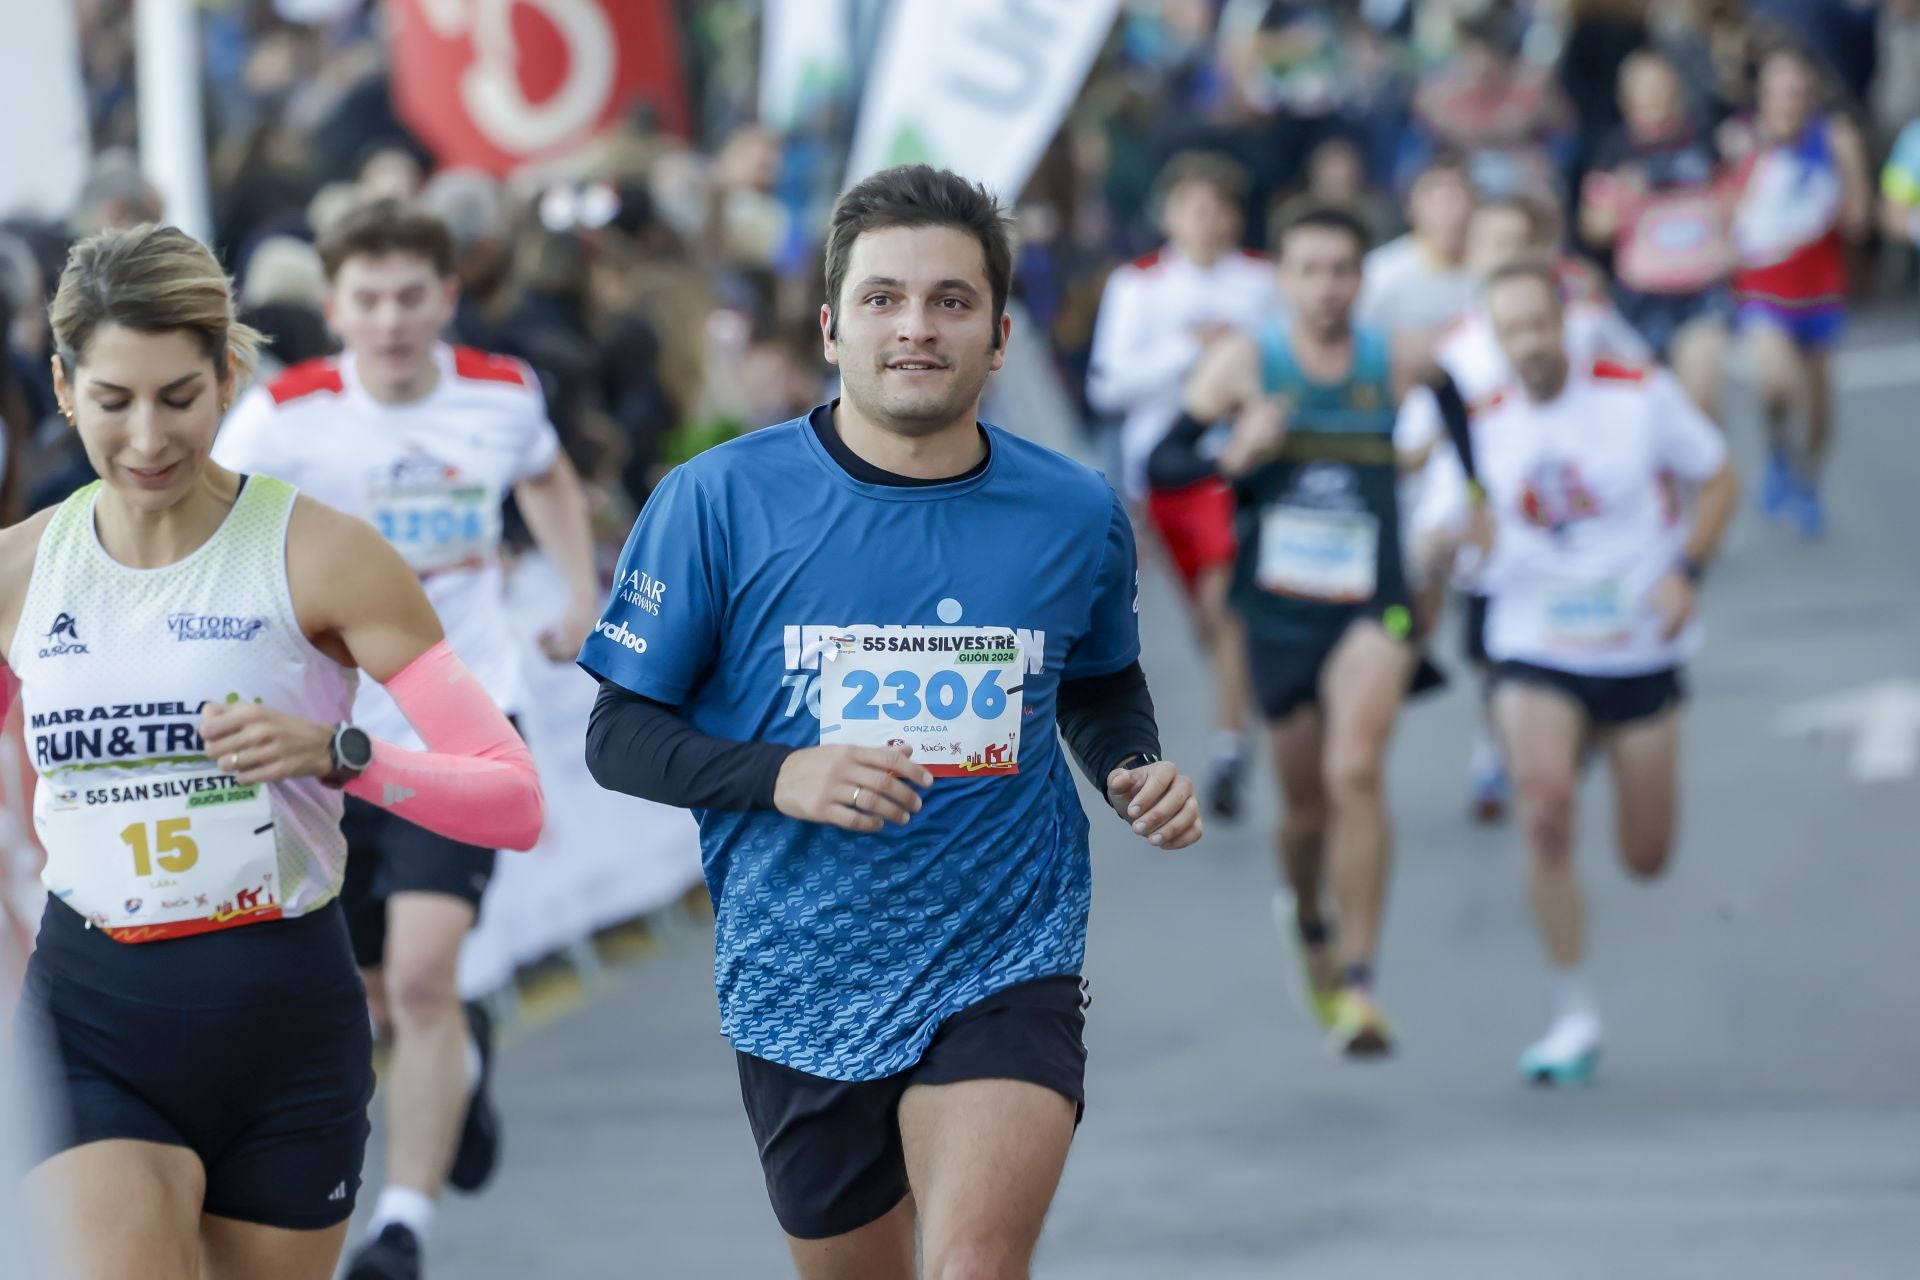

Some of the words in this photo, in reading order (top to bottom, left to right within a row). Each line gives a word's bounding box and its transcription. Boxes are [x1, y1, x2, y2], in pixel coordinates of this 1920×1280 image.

[617, 567, 667, 603] ATAR
[620, 588, 660, 616] AIRWAYS
[167, 615, 246, 631] VICTORY
[862, 636, 886, 652] 55
[888, 636, 925, 652] SAN
[928, 634, 1015, 652] SILVESTRE
[959, 651, 989, 662] GIJÓN
[991, 652, 1014, 661] 2024
[842, 669, 1007, 720] 2306
[903, 725, 948, 733] GONZAGA
[86, 788, 108, 805] 55
[111, 784, 149, 802] SAN
[153, 775, 242, 798] SILVESTR
[120, 817, 199, 877] 15
